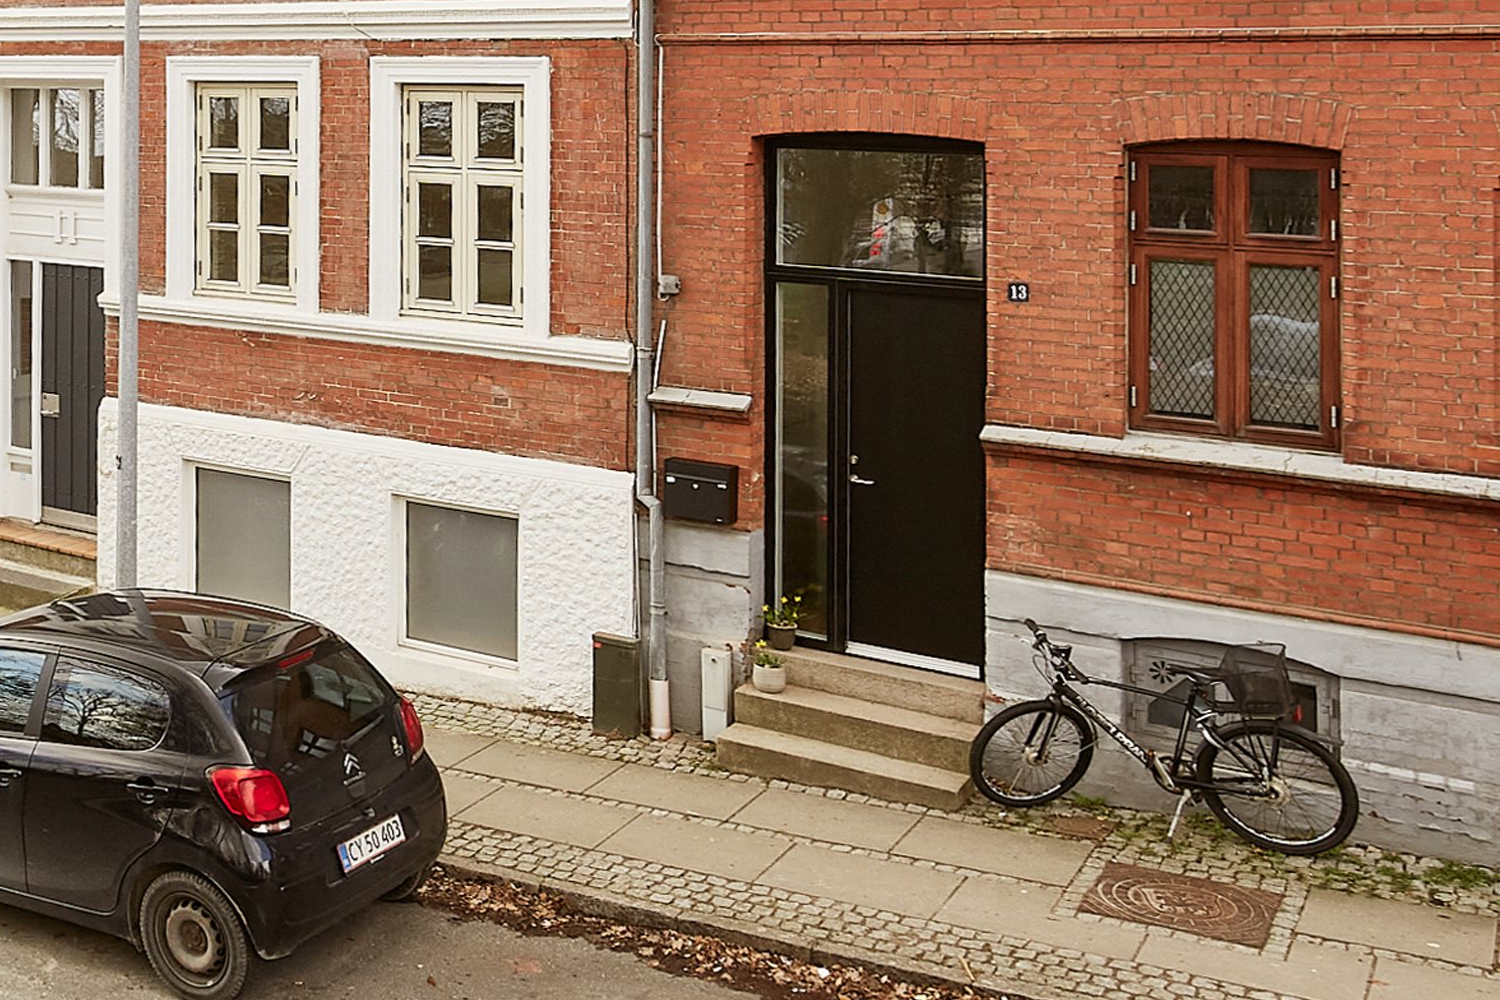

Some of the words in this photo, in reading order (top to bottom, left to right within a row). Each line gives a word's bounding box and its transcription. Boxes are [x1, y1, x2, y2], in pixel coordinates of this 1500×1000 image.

[1010, 285, 1027, 299] 13
[349, 839, 364, 861] CY
[364, 831, 380, 853] 50
[382, 820, 402, 843] 403
